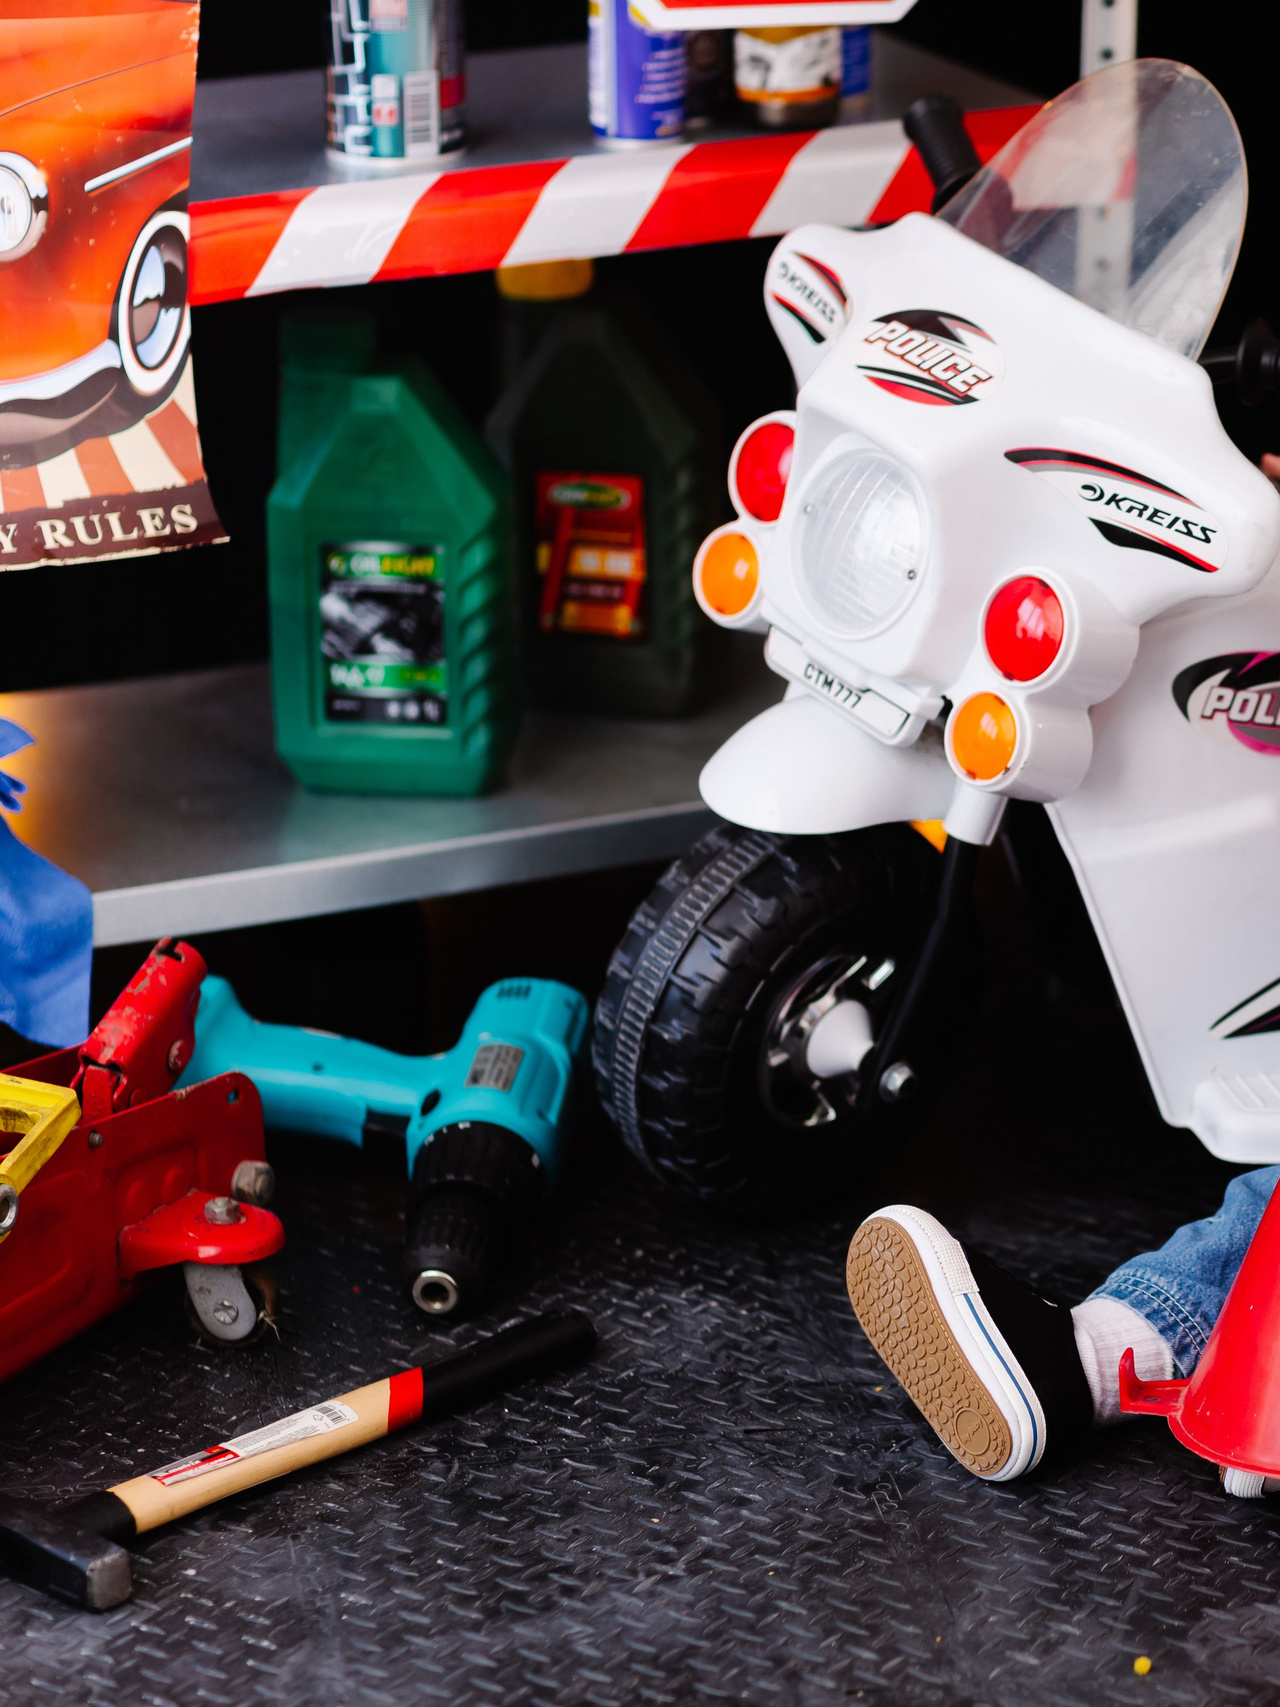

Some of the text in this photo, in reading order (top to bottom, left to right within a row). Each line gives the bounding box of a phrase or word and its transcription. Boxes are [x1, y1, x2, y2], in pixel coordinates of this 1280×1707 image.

[863, 319, 994, 398] POLICE
[36, 503, 199, 550] RULES
[1103, 492, 1218, 545] KREISS
